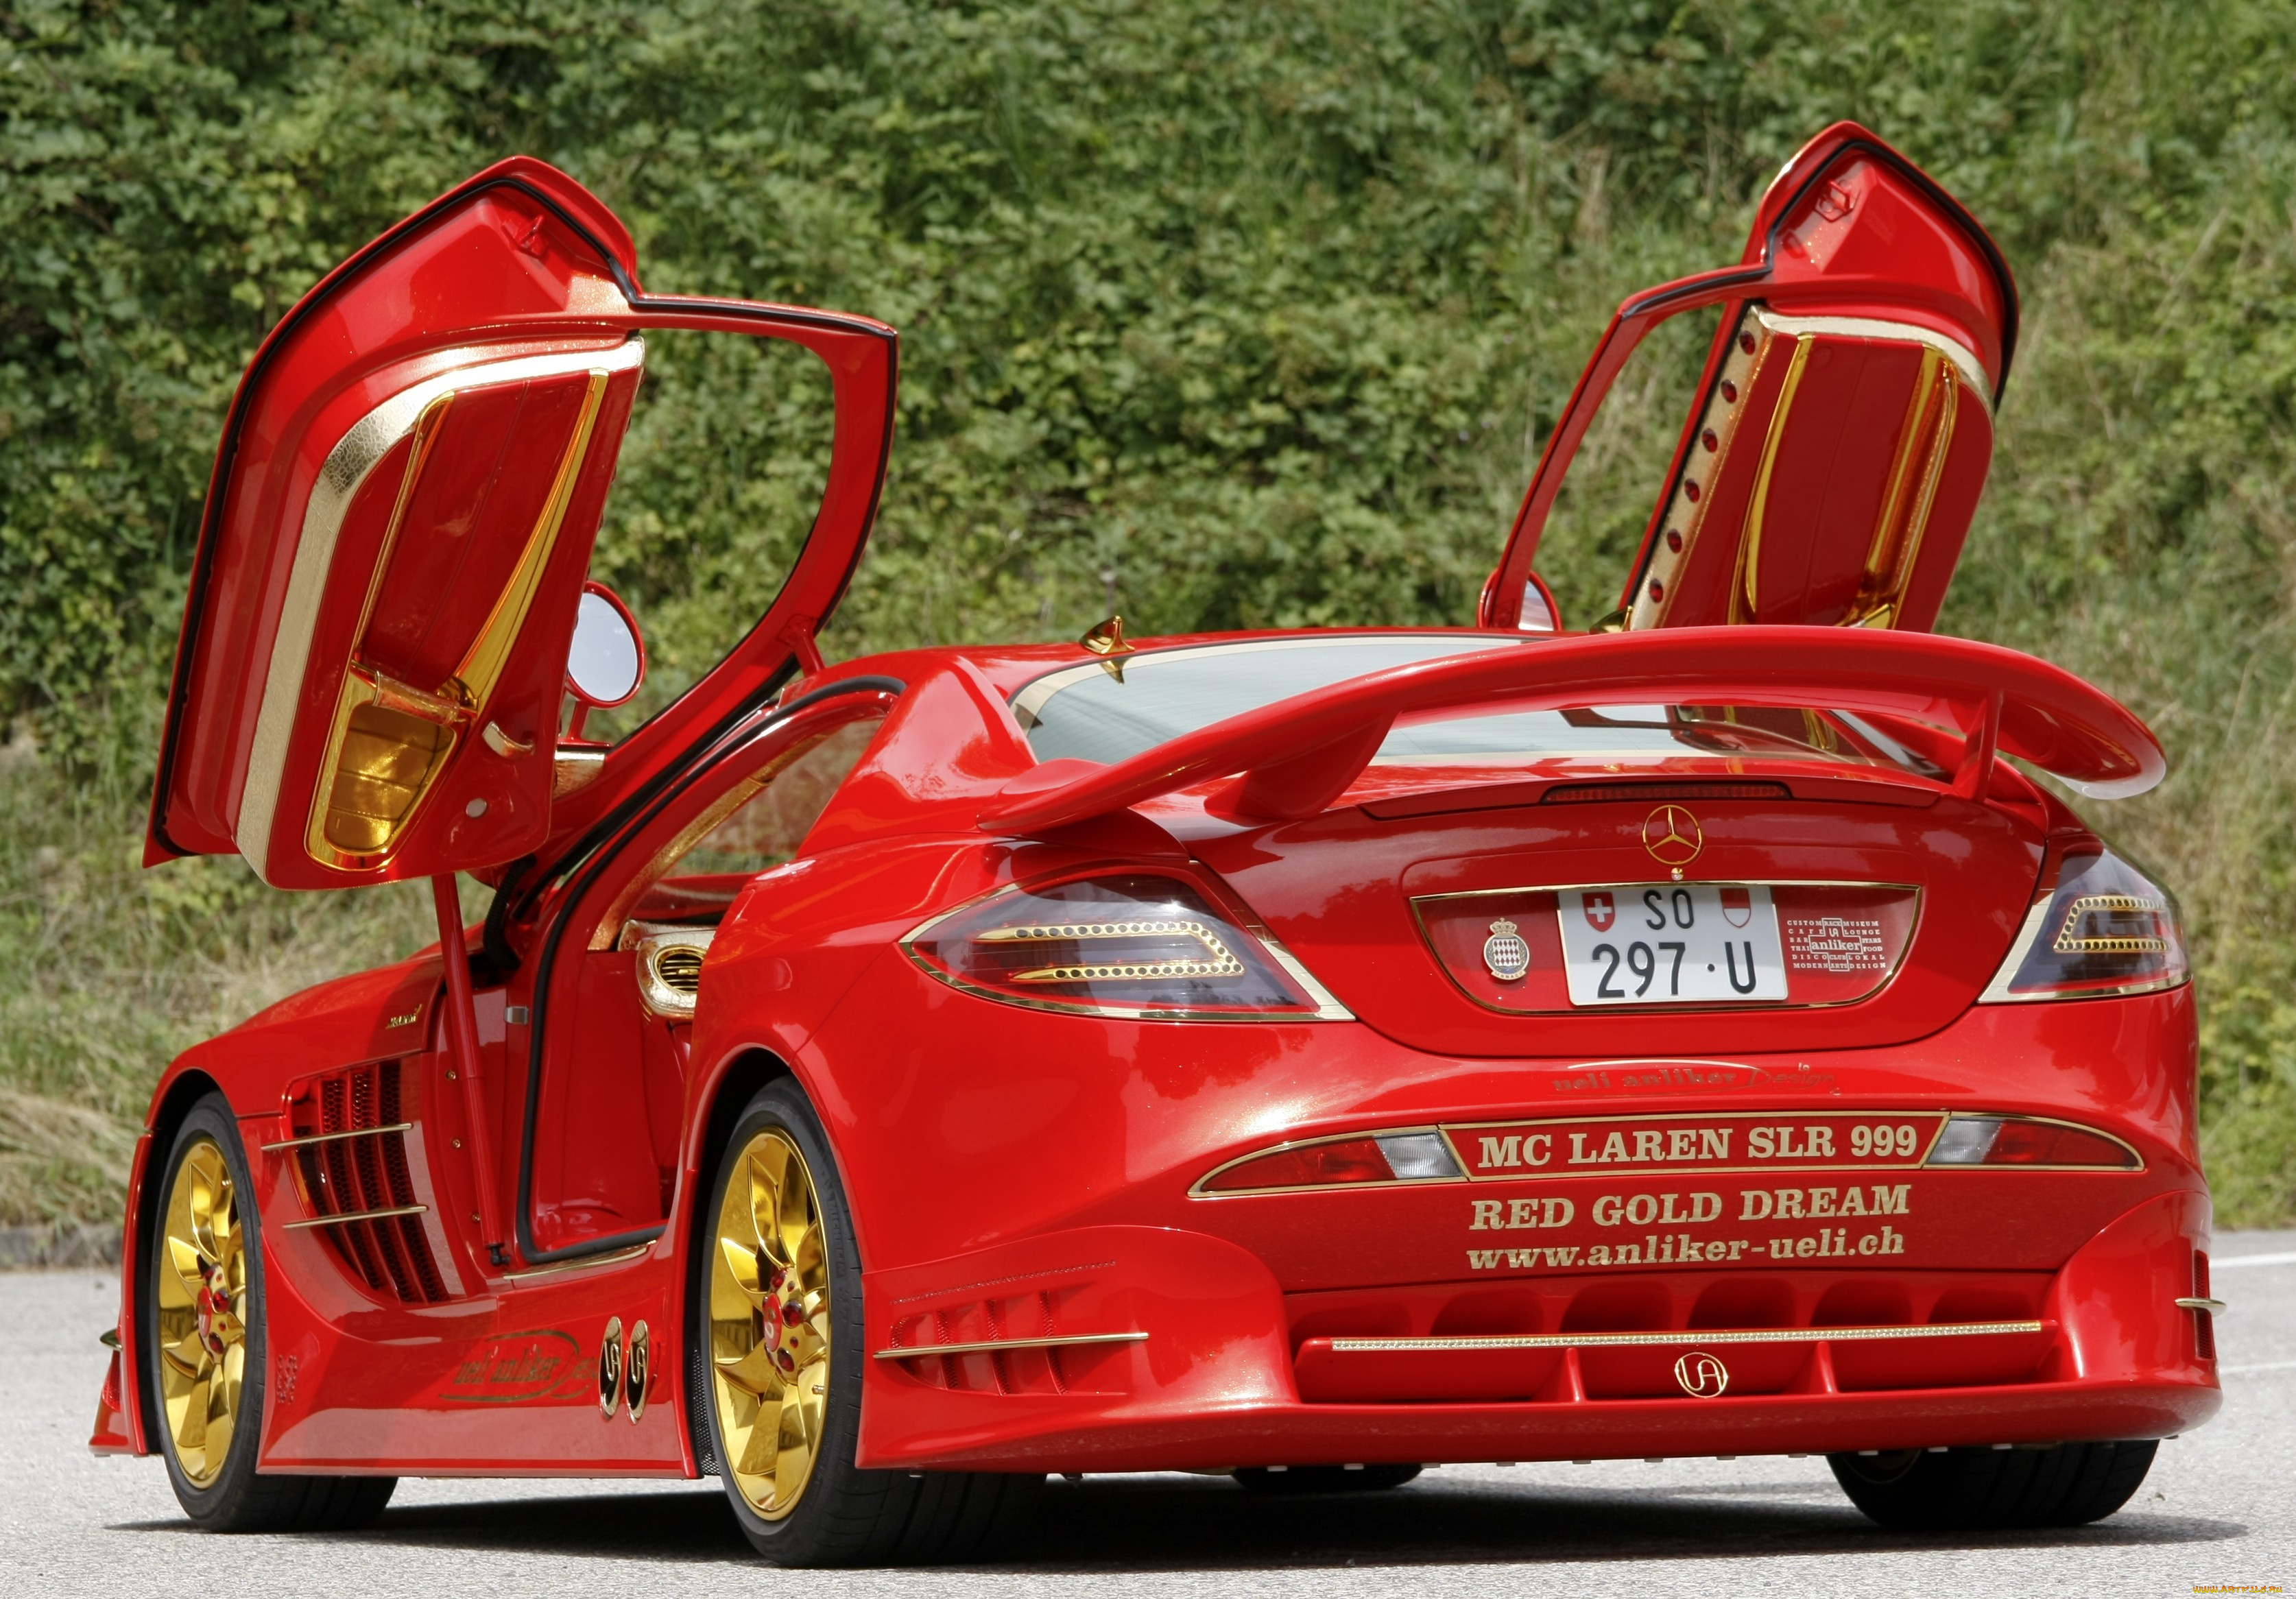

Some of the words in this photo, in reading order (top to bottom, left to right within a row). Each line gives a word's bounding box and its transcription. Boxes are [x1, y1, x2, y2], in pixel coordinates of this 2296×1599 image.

[1643, 889, 1695, 930] SO
[1811, 939, 1861, 950] anliker
[1621, 1068, 1738, 1087] anliker
[1478, 1134, 1551, 1168] MC
[1568, 1129, 1732, 1164] LAREN
[1747, 1126, 1836, 1159] SLR
[1851, 1125, 1917, 1157] 999
[1468, 1199, 1575, 1230] RED
[1592, 1192, 1723, 1226] GOLD
[1738, 1184, 1912, 1221] DREAM
[1466, 1226, 1905, 1270] www.anliker-ueli.ch
